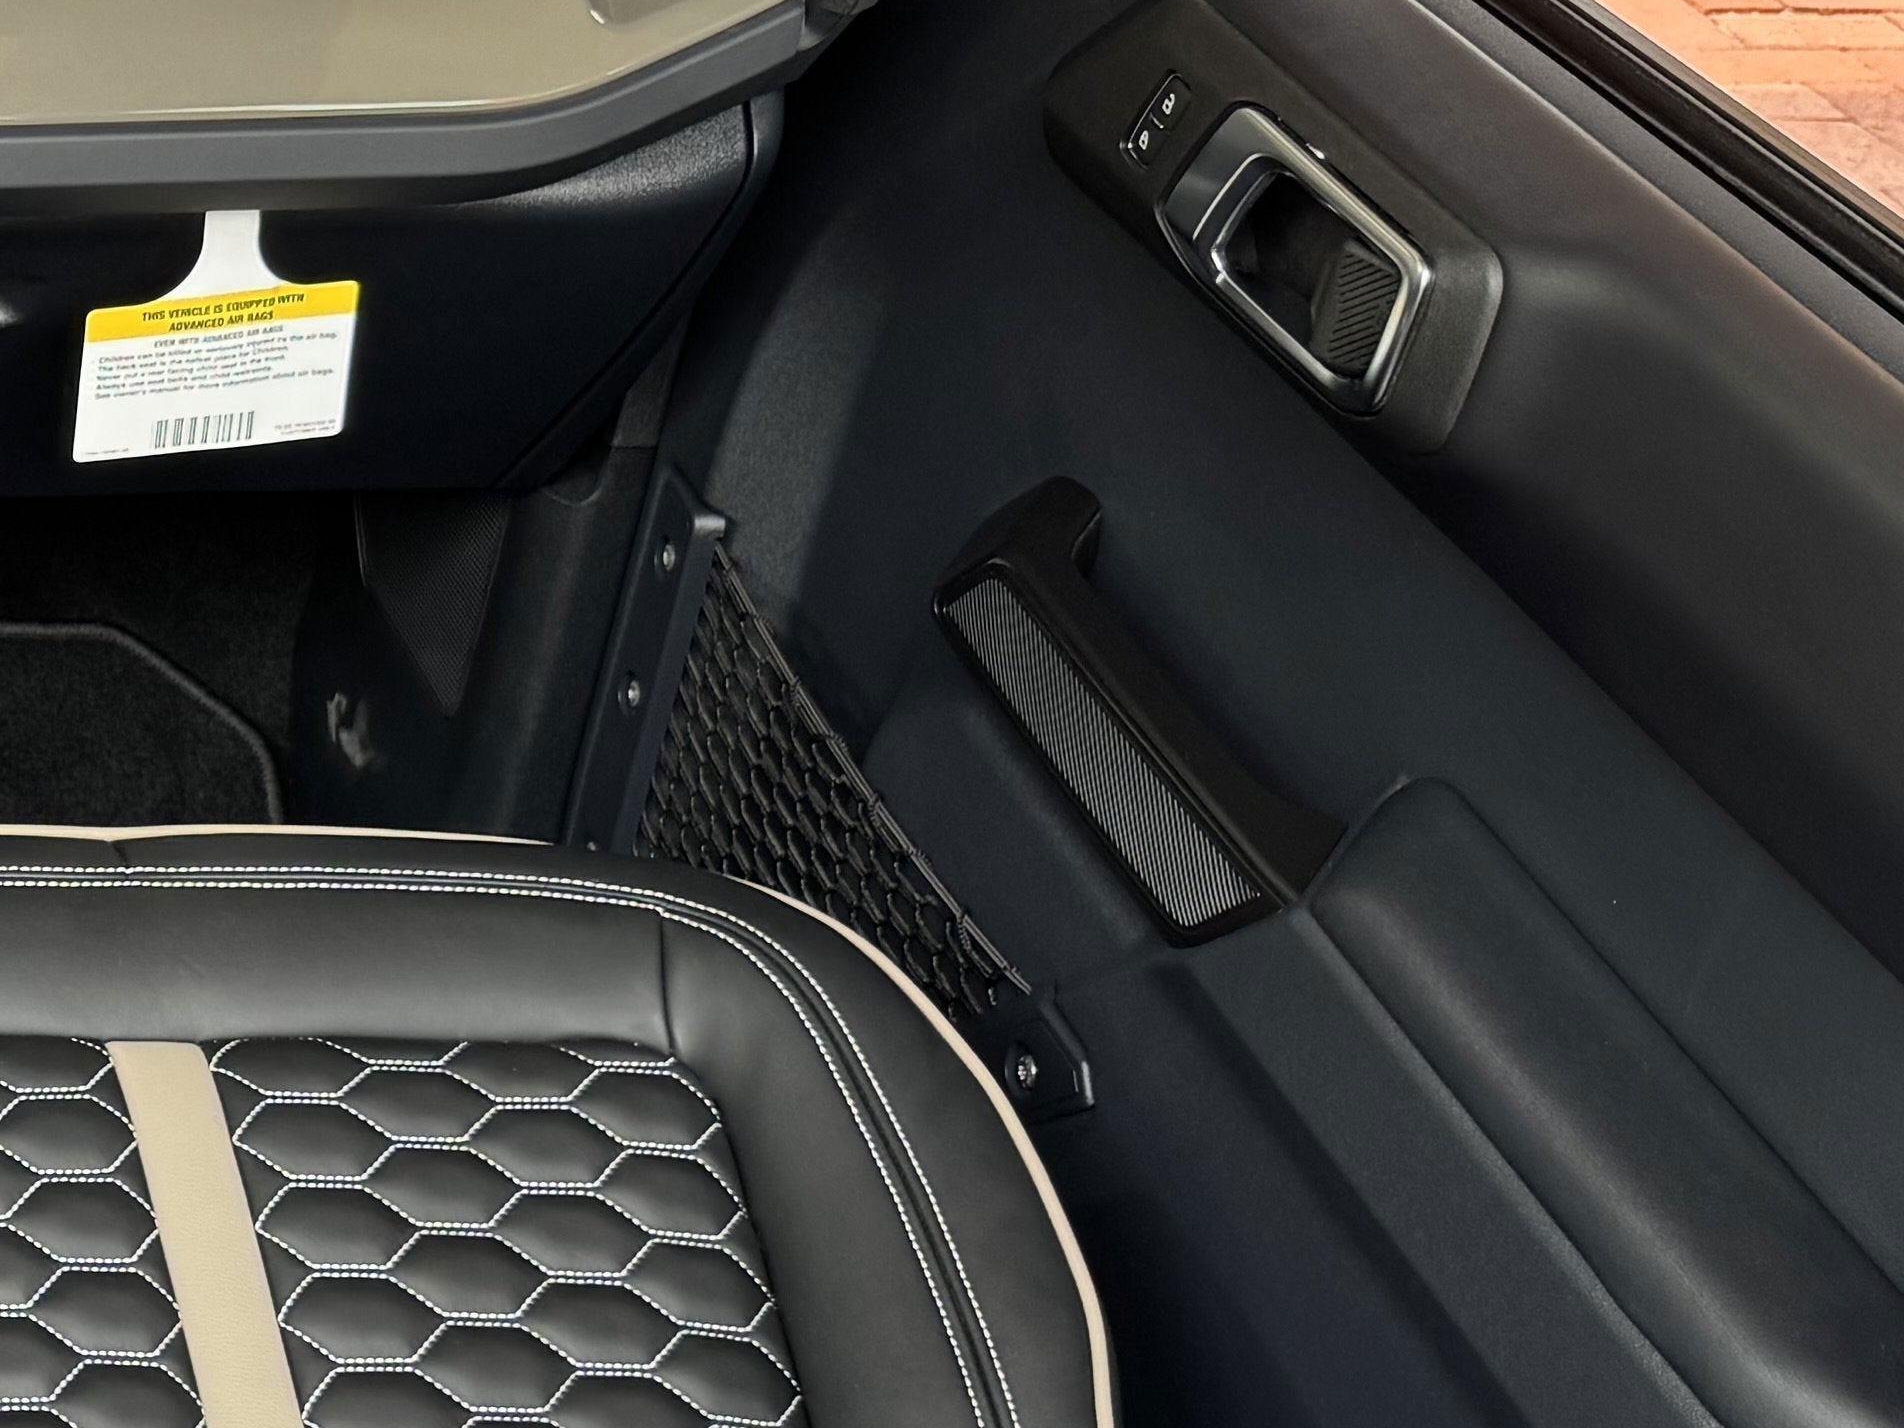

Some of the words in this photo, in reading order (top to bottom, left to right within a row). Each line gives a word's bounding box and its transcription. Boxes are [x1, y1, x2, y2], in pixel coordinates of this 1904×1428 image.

[142, 310, 166, 322] THIS
[168, 304, 212, 320] VEHICLE
[213, 303, 224, 314] IS
[226, 296, 276, 312] EQUIPPED
[277, 293, 305, 304] WITH
[168, 317, 225, 333] ADVANCED
[227, 315, 244, 325] AIR
[247, 310, 274, 322] BAGS
